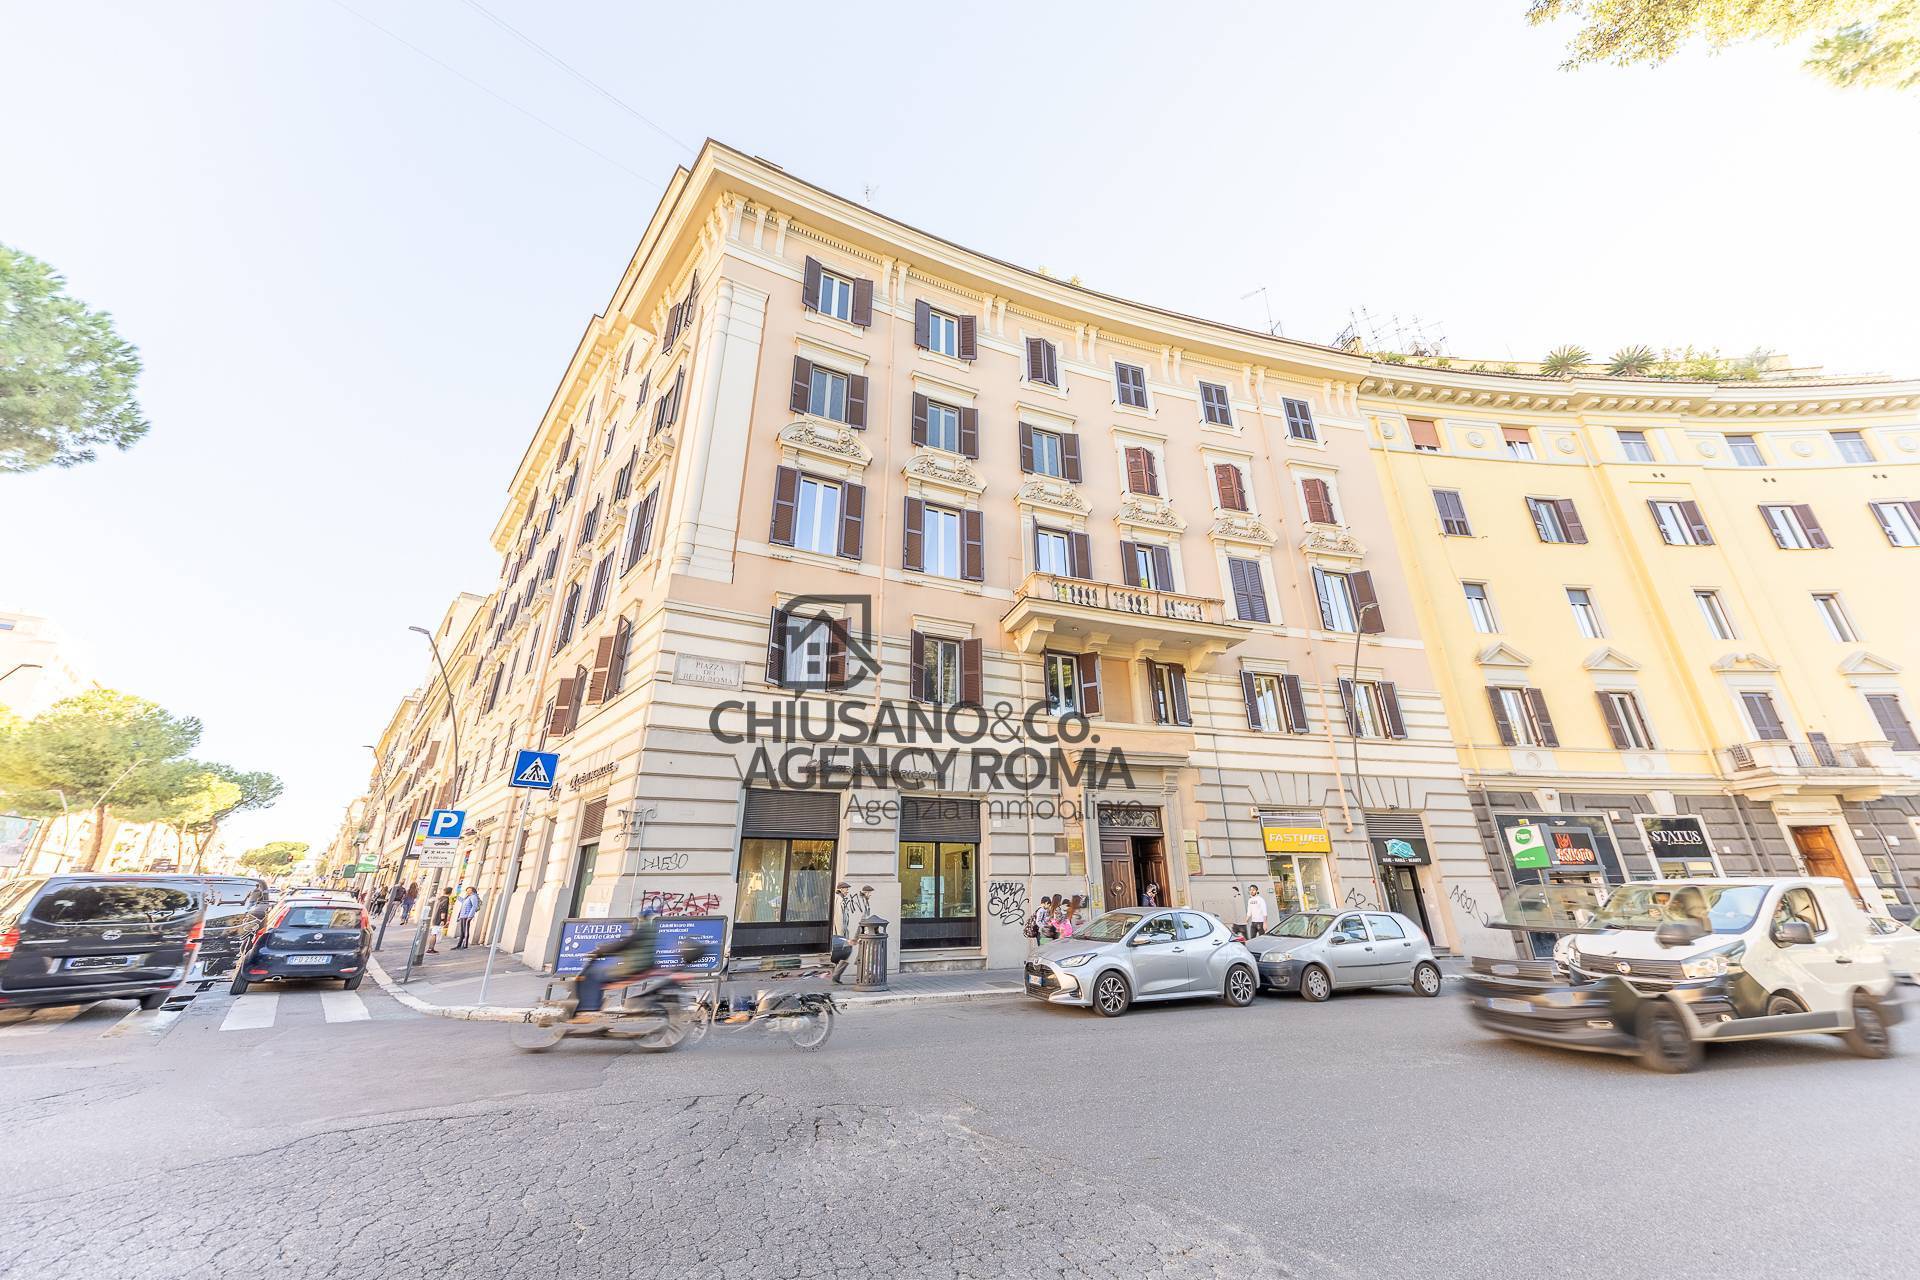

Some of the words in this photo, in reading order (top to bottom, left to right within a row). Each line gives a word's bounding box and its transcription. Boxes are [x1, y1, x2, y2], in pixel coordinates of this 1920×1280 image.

[695, 661, 725, 671] PIAZZA
[434, 812, 458, 835] P
[1269, 833, 1327, 845] FASTWEB
[1652, 830, 1701, 845] STATUS
[574, 924, 623, 934] L'ATELIER
